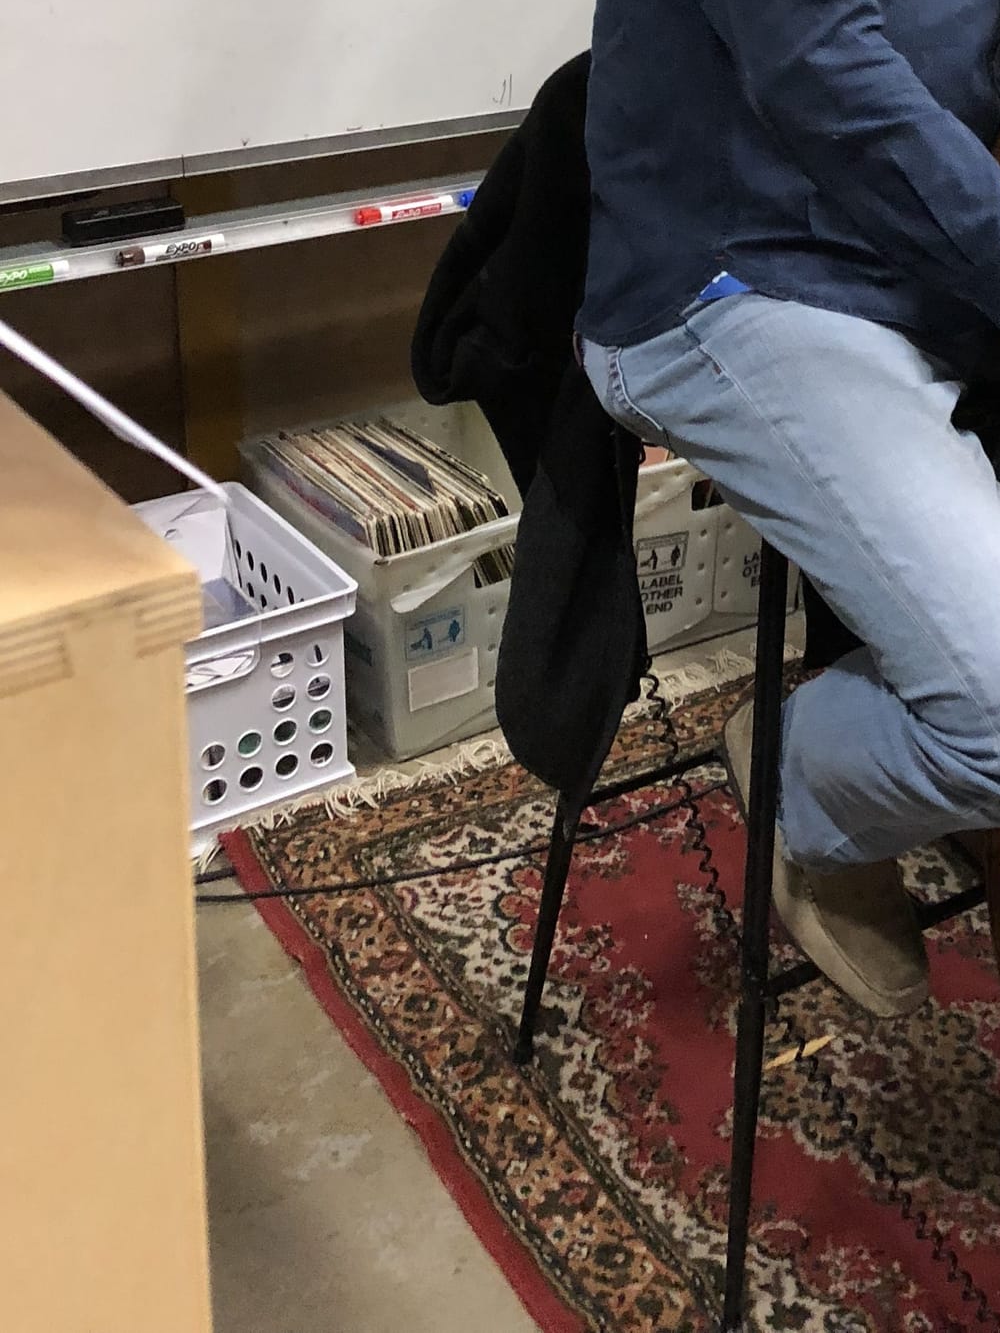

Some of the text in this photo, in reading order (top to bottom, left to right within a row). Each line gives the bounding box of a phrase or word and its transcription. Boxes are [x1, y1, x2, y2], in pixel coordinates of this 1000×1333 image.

[165, 241, 197, 255] EXPO
[641, 574, 683, 590] LABEL
[646, 601, 673, 615] END
